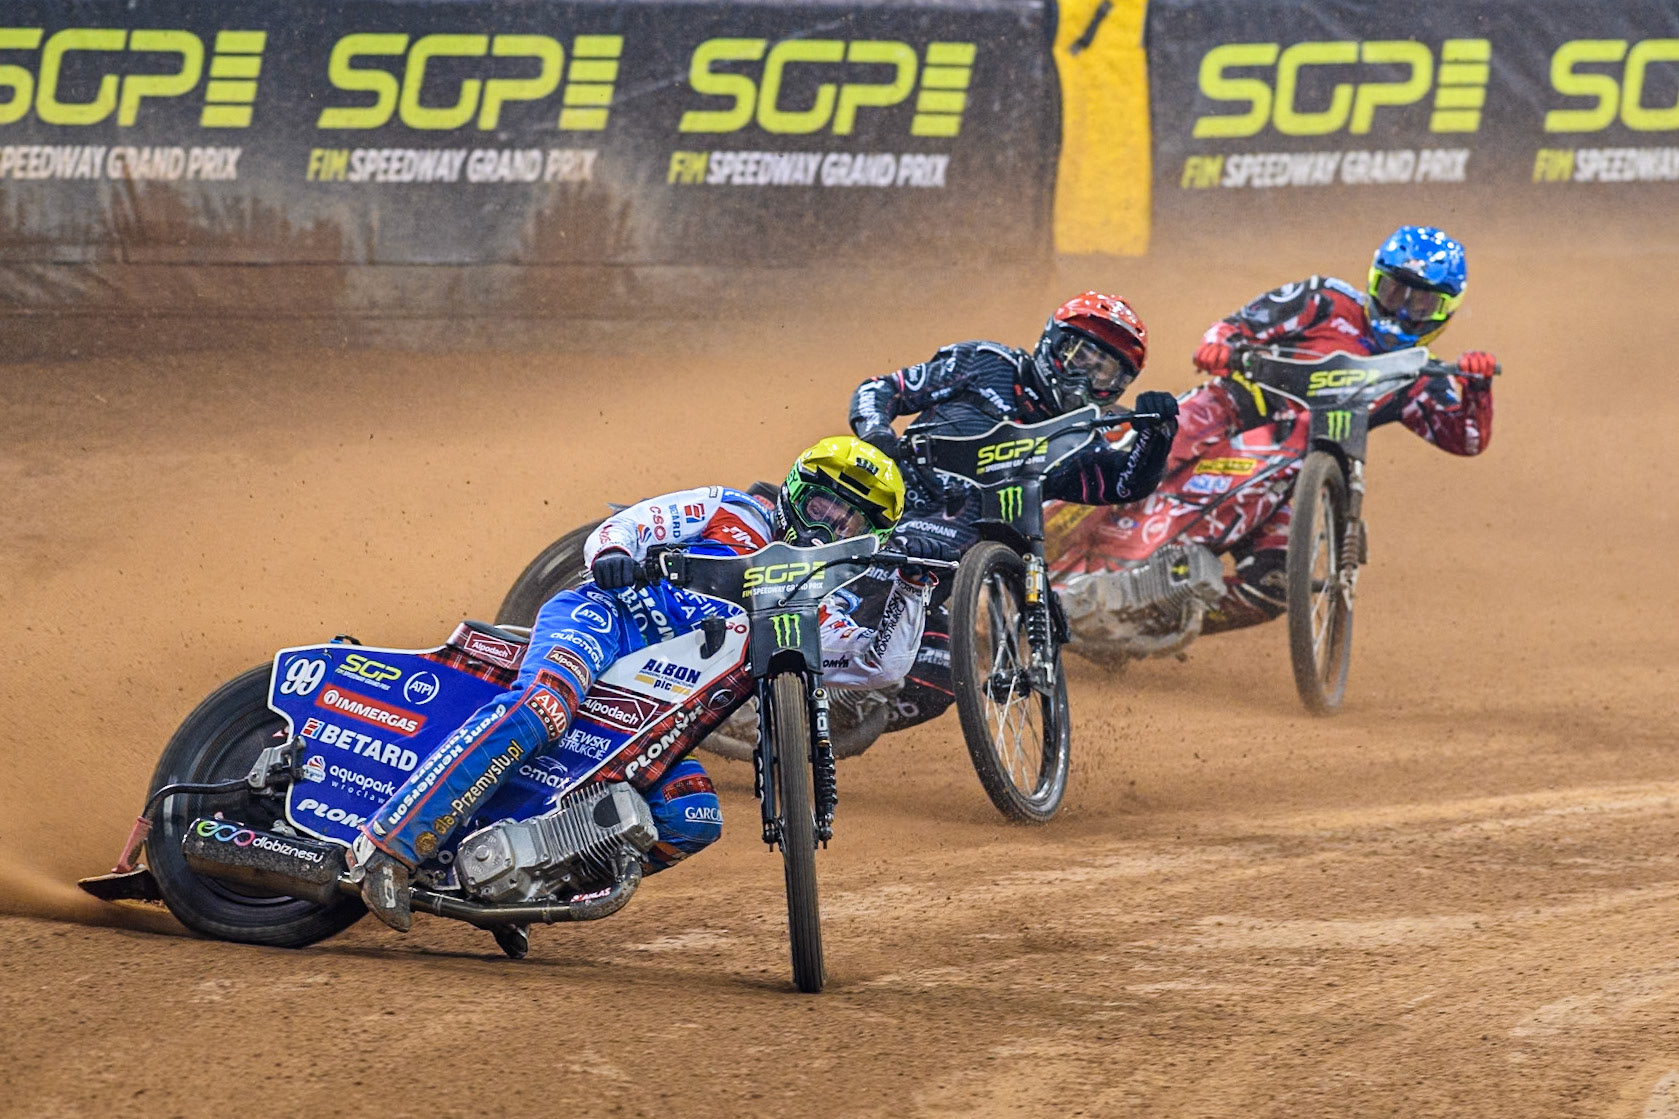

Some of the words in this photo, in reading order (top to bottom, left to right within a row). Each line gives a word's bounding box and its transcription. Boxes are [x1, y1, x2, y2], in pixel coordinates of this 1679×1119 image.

[317, 33, 565, 130] SGP
[678, 38, 918, 136] SGP
[1193, 40, 1433, 139] SGP
[0, 145, 107, 180] PEEDWAY
[106, 146, 186, 180] GRAND
[186, 146, 242, 181] PRIX
[306, 148, 348, 182] FIM
[349, 148, 467, 183] SPEEDWAY
[466, 149, 543, 183] GRAND
[543, 149, 599, 183] PRIX
[667, 151, 708, 185] FIM
[706, 150, 823, 186] SPEEDWAY
[820, 152, 897, 187] GRAND
[896, 153, 949, 188] PRIX
[1181, 155, 1223, 189] FIM
[1221, 151, 1341, 188] SPEEDWAY
[1340, 149, 1416, 185] GRAND
[1414, 148, 1470, 183] PRIX
[1532, 148, 1575, 183] FIM
[977, 438, 1035, 466] SGP
[742, 561, 810, 589] SGP
[753, 584, 786, 596] SPEEDWAY
[785, 583, 808, 592] GRND
[808, 581, 824, 590] PRIX
[471, 640, 509, 659] Alpodach
[279, 657, 327, 696] 99
[339, 653, 403, 682] SGP
[549, 652, 588, 687] Alpodach
[641, 657, 702, 685] ALBON
[408, 680, 435, 697] ATPI
[335, 696, 418, 733] IMMERGAS
[463, 703, 507, 745] Grant
[580, 697, 640, 725] Alpodach
[319, 723, 419, 772] BETARD
[329, 765, 396, 797] aquapark
[388, 744, 465, 826] Henderson
